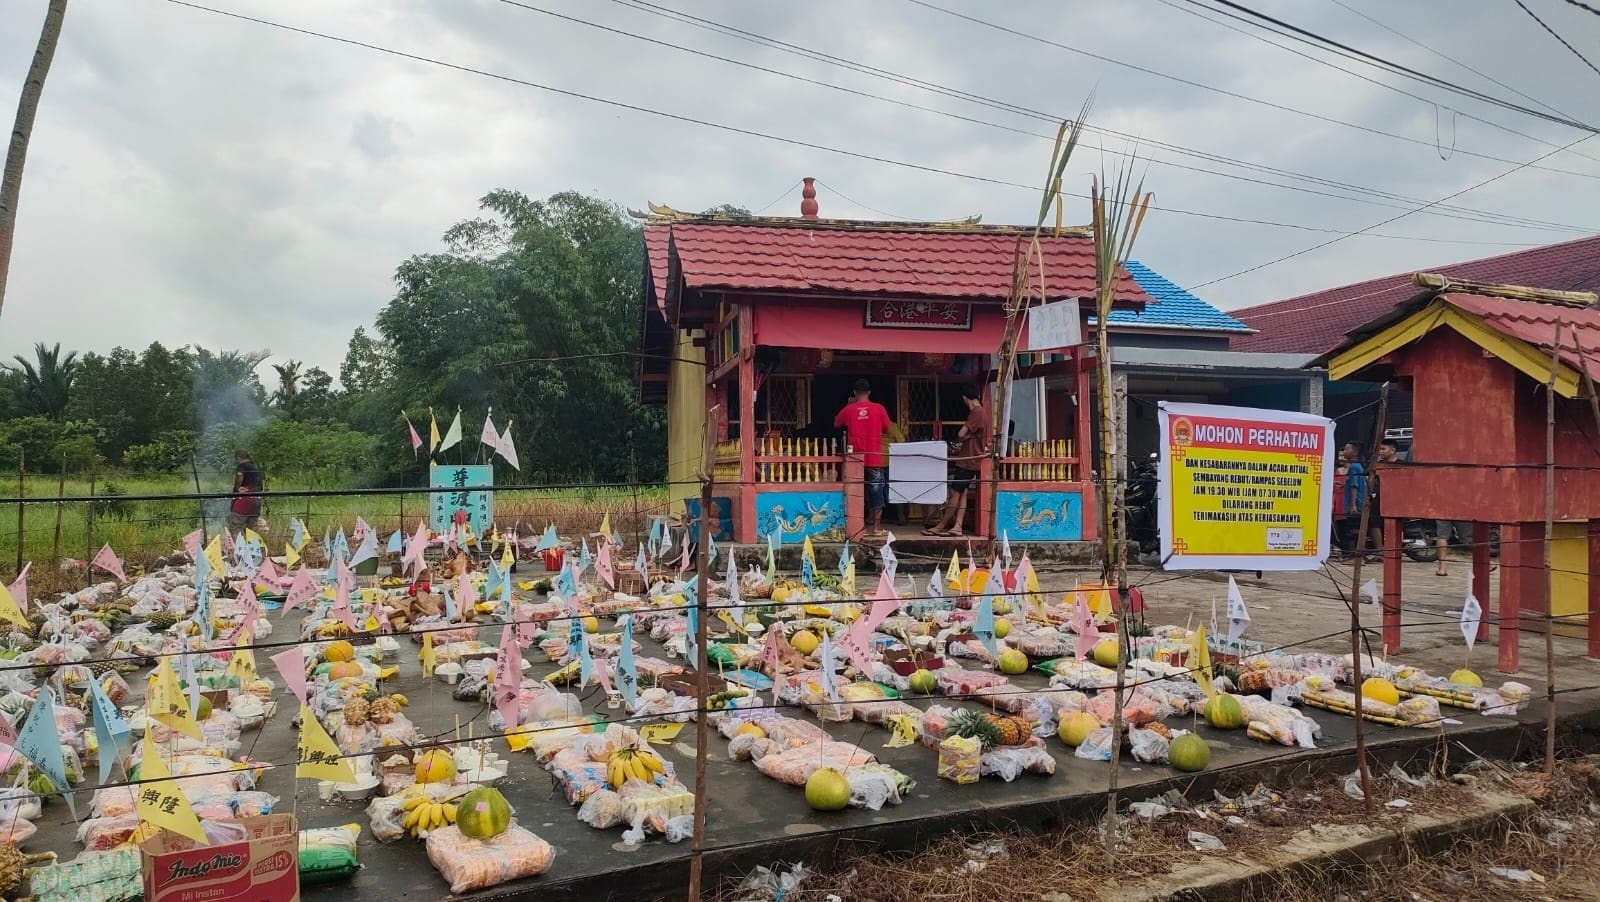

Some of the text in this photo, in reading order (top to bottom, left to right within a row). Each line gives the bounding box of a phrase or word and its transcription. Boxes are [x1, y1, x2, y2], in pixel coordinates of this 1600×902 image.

[1195, 424, 1318, 449] MOHON PERHATIAN
[1185, 458, 1309, 474] DAN KESABARANNYA DALAM ACARA RITUAL
[1193, 473, 1302, 486] SEMBAYANG REBUT/RAMPAS SEBELUM
[451, 467, 475, 523] 普渡
[1193, 486, 1302, 499] JAM 19.30 WIB (JAM 07.30 MALAM)
[1222, 499, 1274, 510] DILARANG REBUT
[1193, 511, 1237, 522] TERIMAKASIH
[1238, 513, 1253, 522] ATAS
[141, 788, 181, 816] 興隆
[275, 852, 289, 869] 15%
[182, 887, 225, 901] Mi Instan
